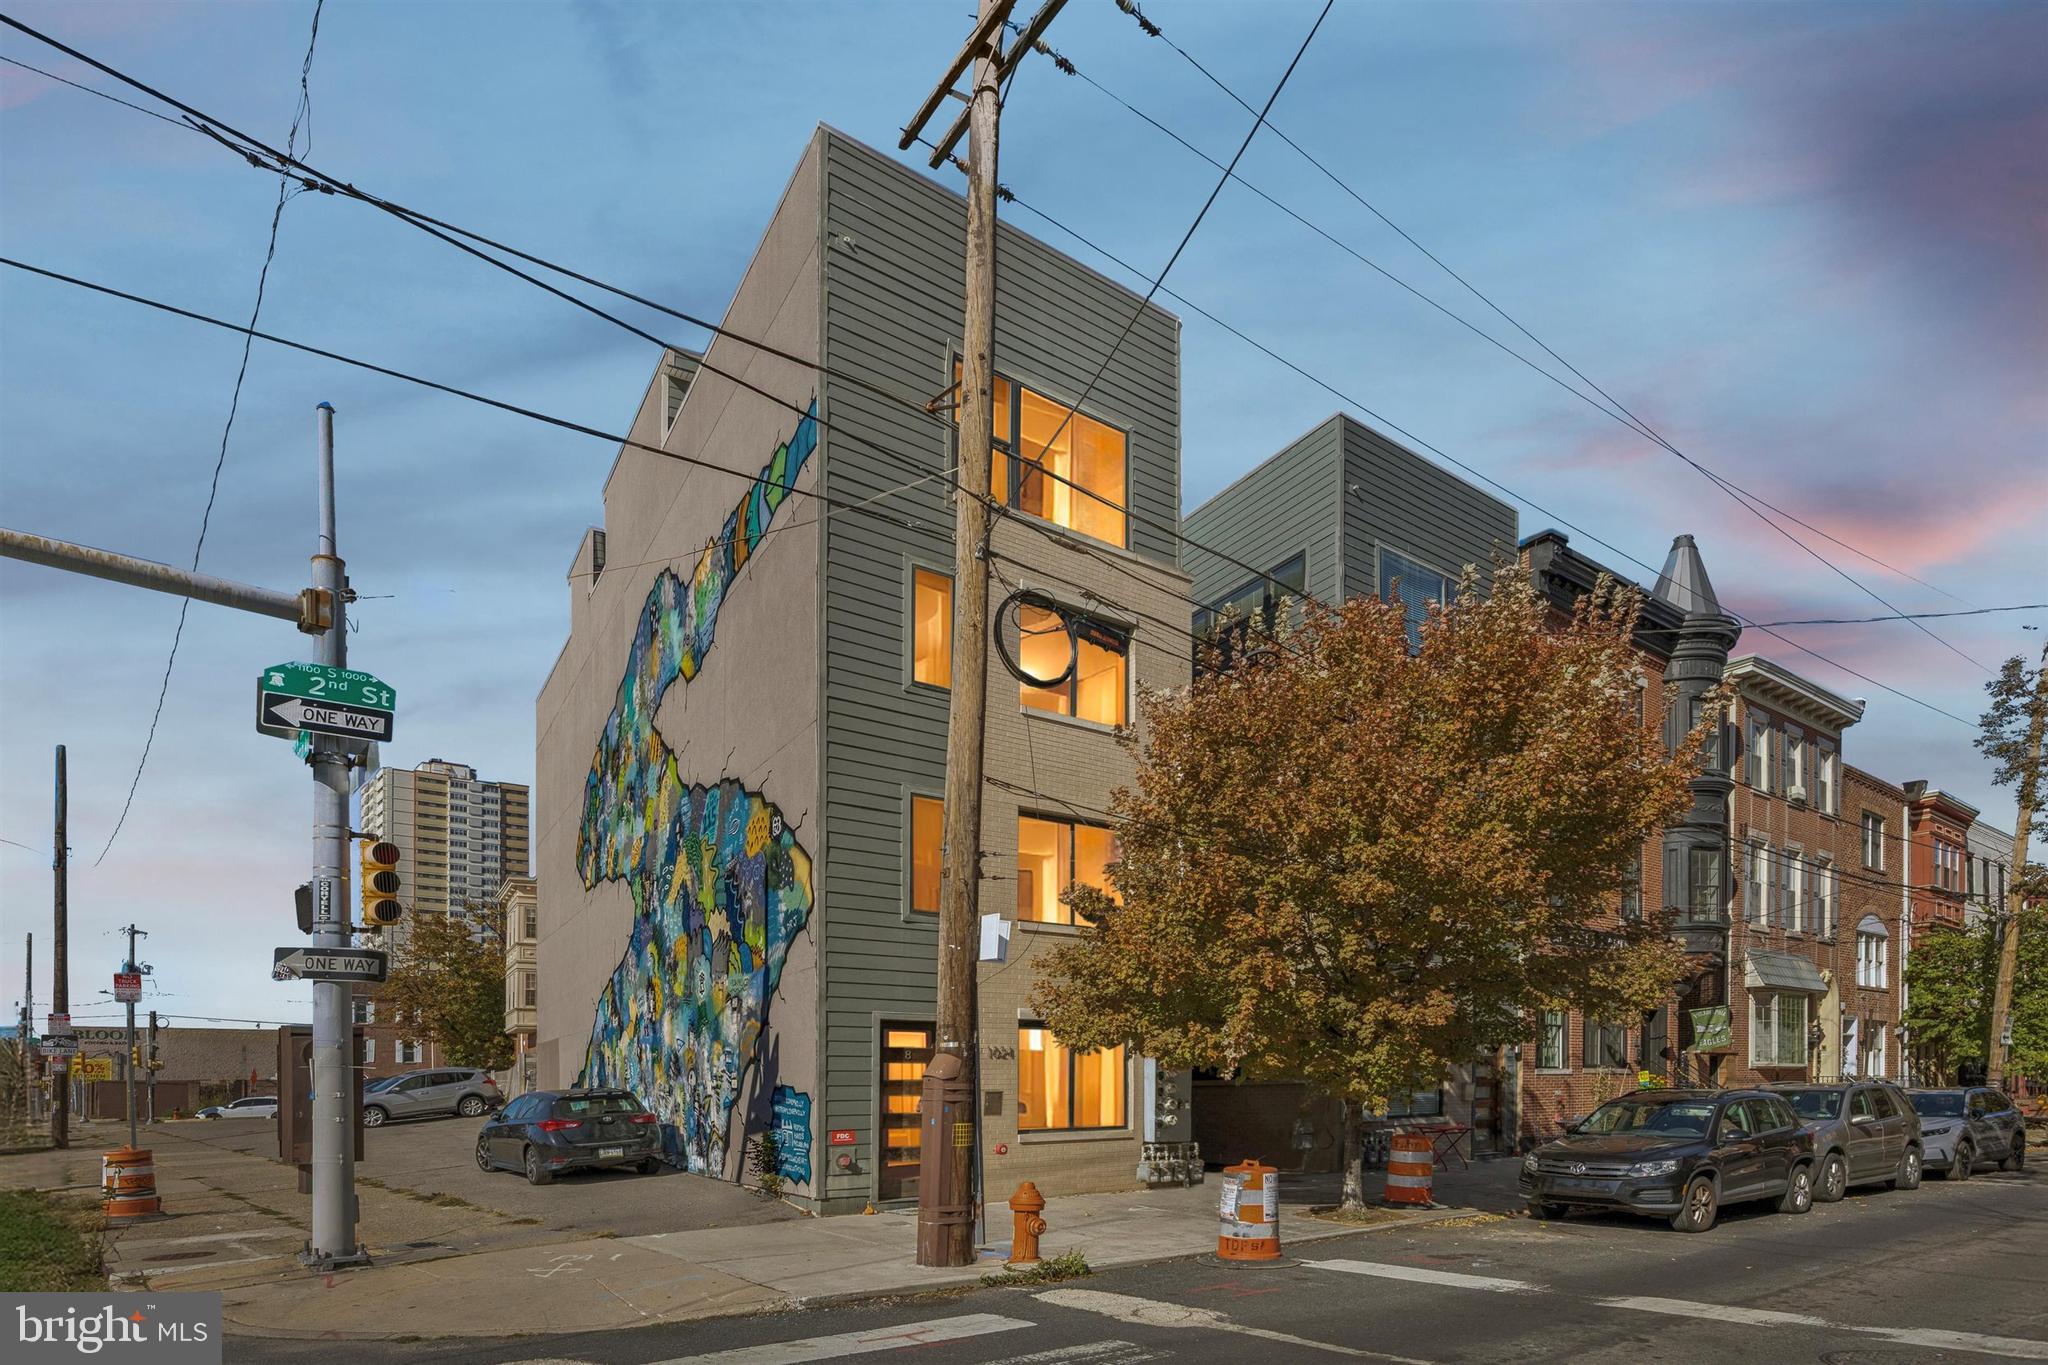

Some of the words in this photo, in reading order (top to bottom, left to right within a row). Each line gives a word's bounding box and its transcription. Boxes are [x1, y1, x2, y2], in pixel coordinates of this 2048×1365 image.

[298, 664, 321, 674] 1100
[327, 668, 337, 678] S
[341, 671, 367, 682] 1000
[309, 677, 348, 696] 2nd
[361, 686, 390, 706] St
[303, 708, 338, 724] ONE
[345, 714, 380, 730] WAY
[304, 957, 337, 971] ONE
[343, 958, 376, 972] WAY
[904, 1050, 912, 1060] 8
